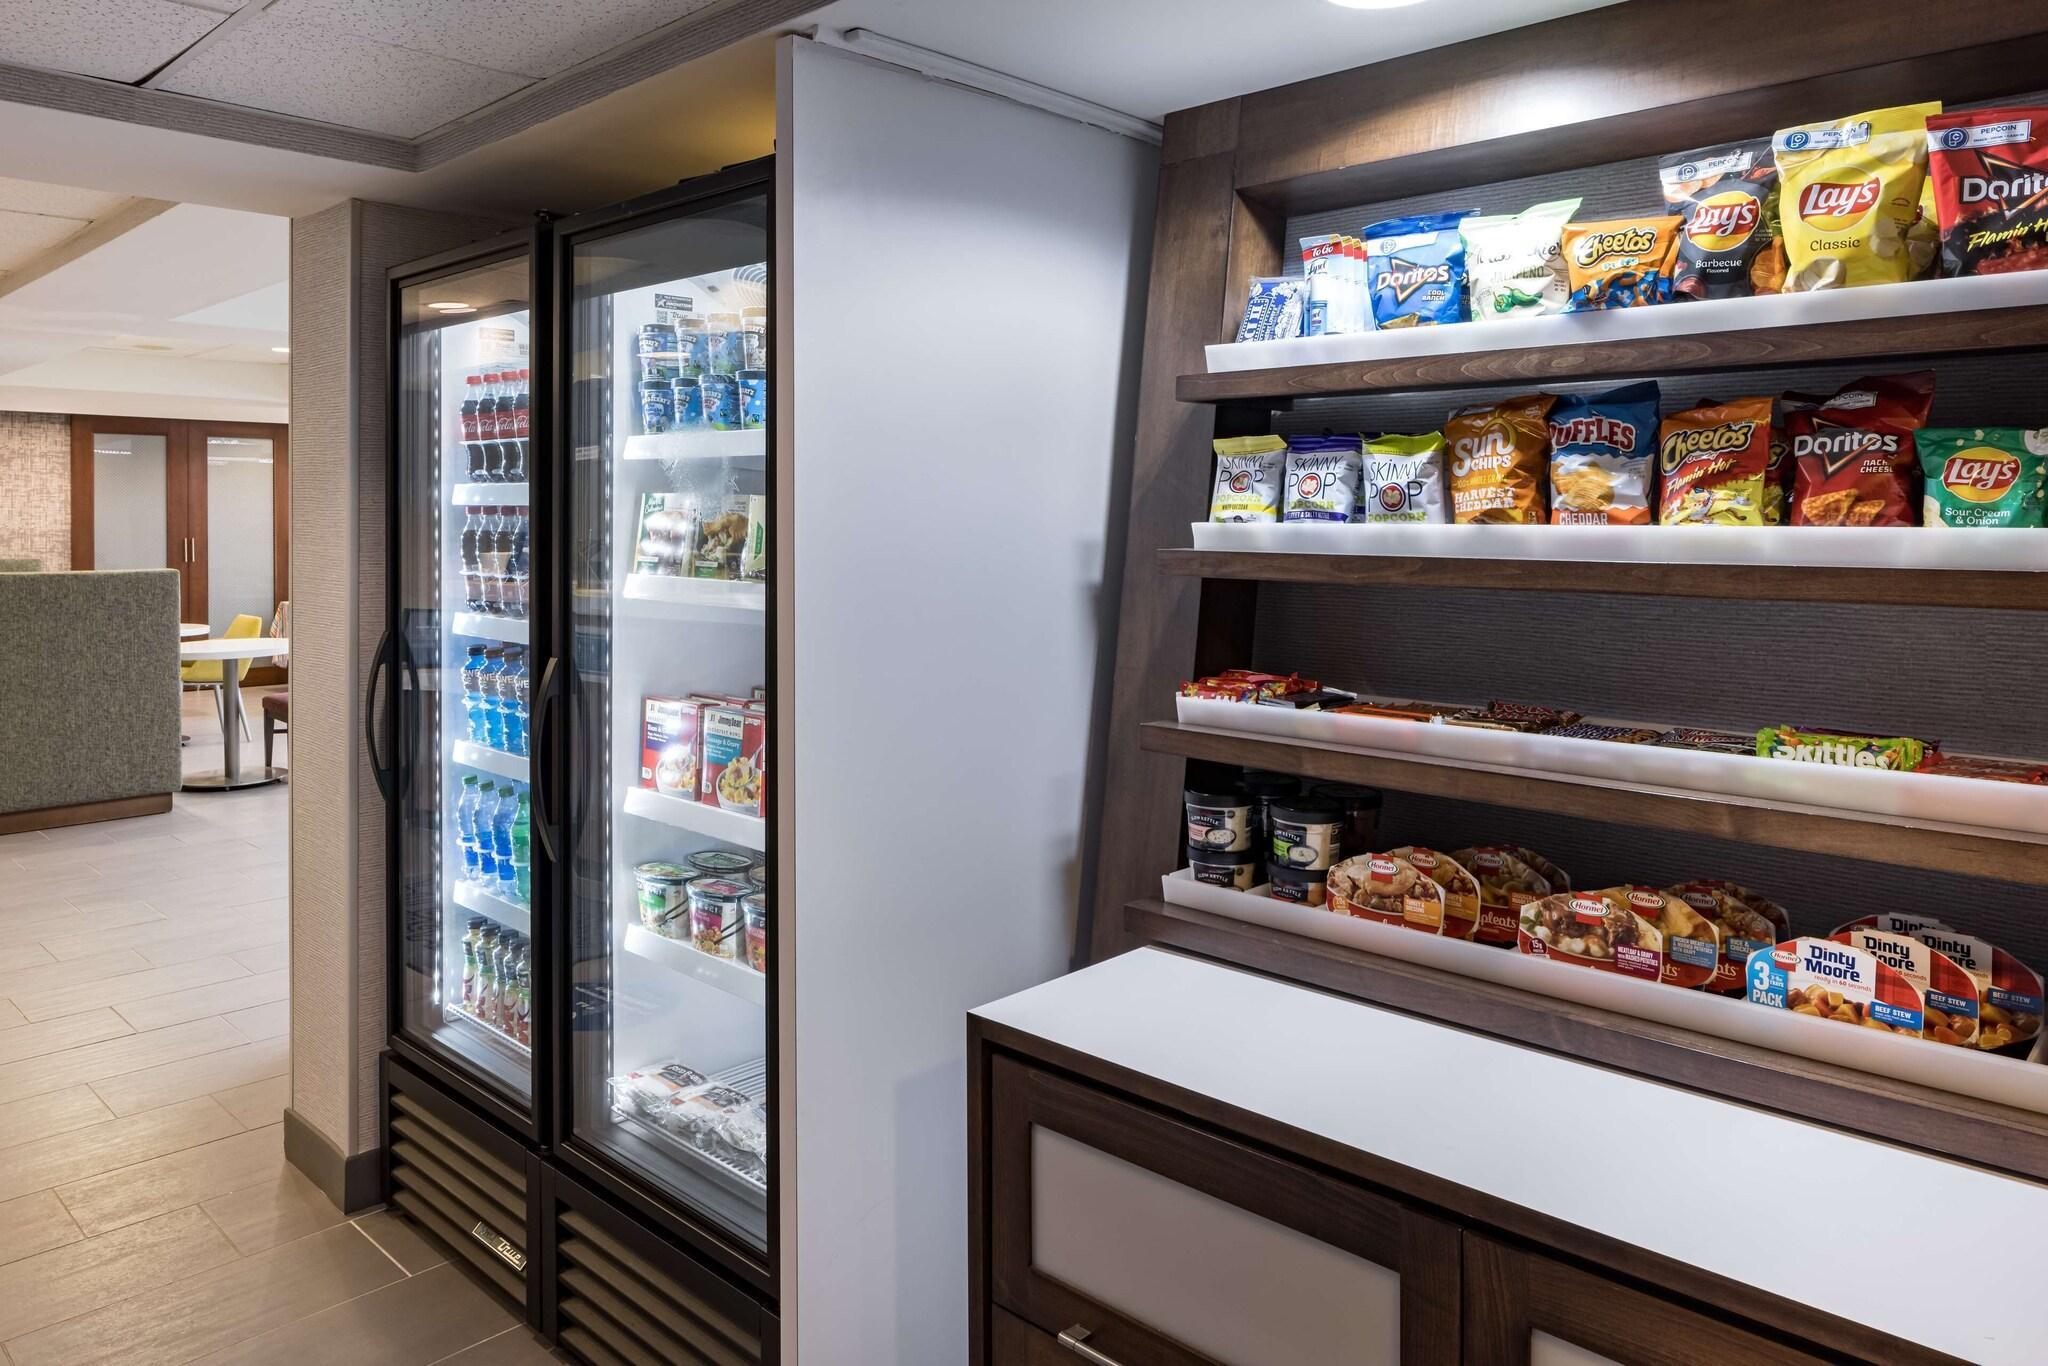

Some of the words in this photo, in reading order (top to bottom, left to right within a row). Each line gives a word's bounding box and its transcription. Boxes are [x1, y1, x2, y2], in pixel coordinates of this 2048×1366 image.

[1980, 124, 2017, 135] PEPCOIN
[1802, 182, 1878, 217] Lay's
[1689, 202, 1756, 237] Lay's
[1810, 237, 1861, 251] Classic
[1967, 221, 2033, 252] Flamin'
[1312, 248, 1322, 257] To
[1322, 244, 1334, 255] Go
[1577, 227, 1655, 266] Cheetos
[1695, 258, 1743, 269] Barbecue
[1376, 265, 1449, 292] Doritos
[1661, 423, 1753, 475] Cheetos
[1794, 431, 1899, 457] Doritos
[1290, 453, 1344, 472] SKINNY
[1452, 430, 1516, 477] Sun
[1470, 454, 1512, 471] CHIPS
[1370, 458, 1422, 481] SKINNY
[1666, 466, 1707, 498] Flamin'
[1707, 457, 1737, 475] Hot
[1947, 457, 2017, 490] Lay's
[1217, 469, 1265, 495] POP
[1287, 472, 1337, 500] POP
[1368, 480, 1423, 513] POP
[1454, 486, 1516, 504] HARVEST
[1454, 496, 1516, 513] CHEDDAR
[1945, 507, 1972, 517] Sour
[1974, 507, 2011, 517] Cream
[1367, 511, 1427, 523] POPCORN
[1559, 512, 1608, 525] CHEDDAR
[1955, 516, 1964, 525] &
[1966, 516, 1999, 525] Onion
[1370, 861, 1395, 872] Hormel
[1411, 855, 1435, 866] Hormel
[1575, 902, 1604, 913] Hormel
[1631, 892, 1661, 906] Hormel
[1863, 935, 1910, 961] Dinty
[1922, 934, 1972, 961] Dinty
[1773, 952, 1798, 963] Hormel
[1809, 944, 1856, 970] Dinty
[1753, 960, 1770, 990] 3
[1804, 957, 1861, 983] Moore
[1903, 971, 1927, 981] seconds
[1814, 975, 1831, 986] ready
[1831, 978, 1838, 986] in
[1838, 979, 1848, 987] 60
[1847, 981, 1872, 993] seconds
[1752, 989, 1784, 1008] PACK
[1930, 993, 1946, 1002] BEEF
[1947, 997, 1967, 1007] STEW
[1992, 990, 2009, 1000] BEEF
[2010, 995, 2031, 1004] STEW
[1874, 1005, 1892, 1015] BEEF
[1892, 1009, 1912, 1019] STEW
